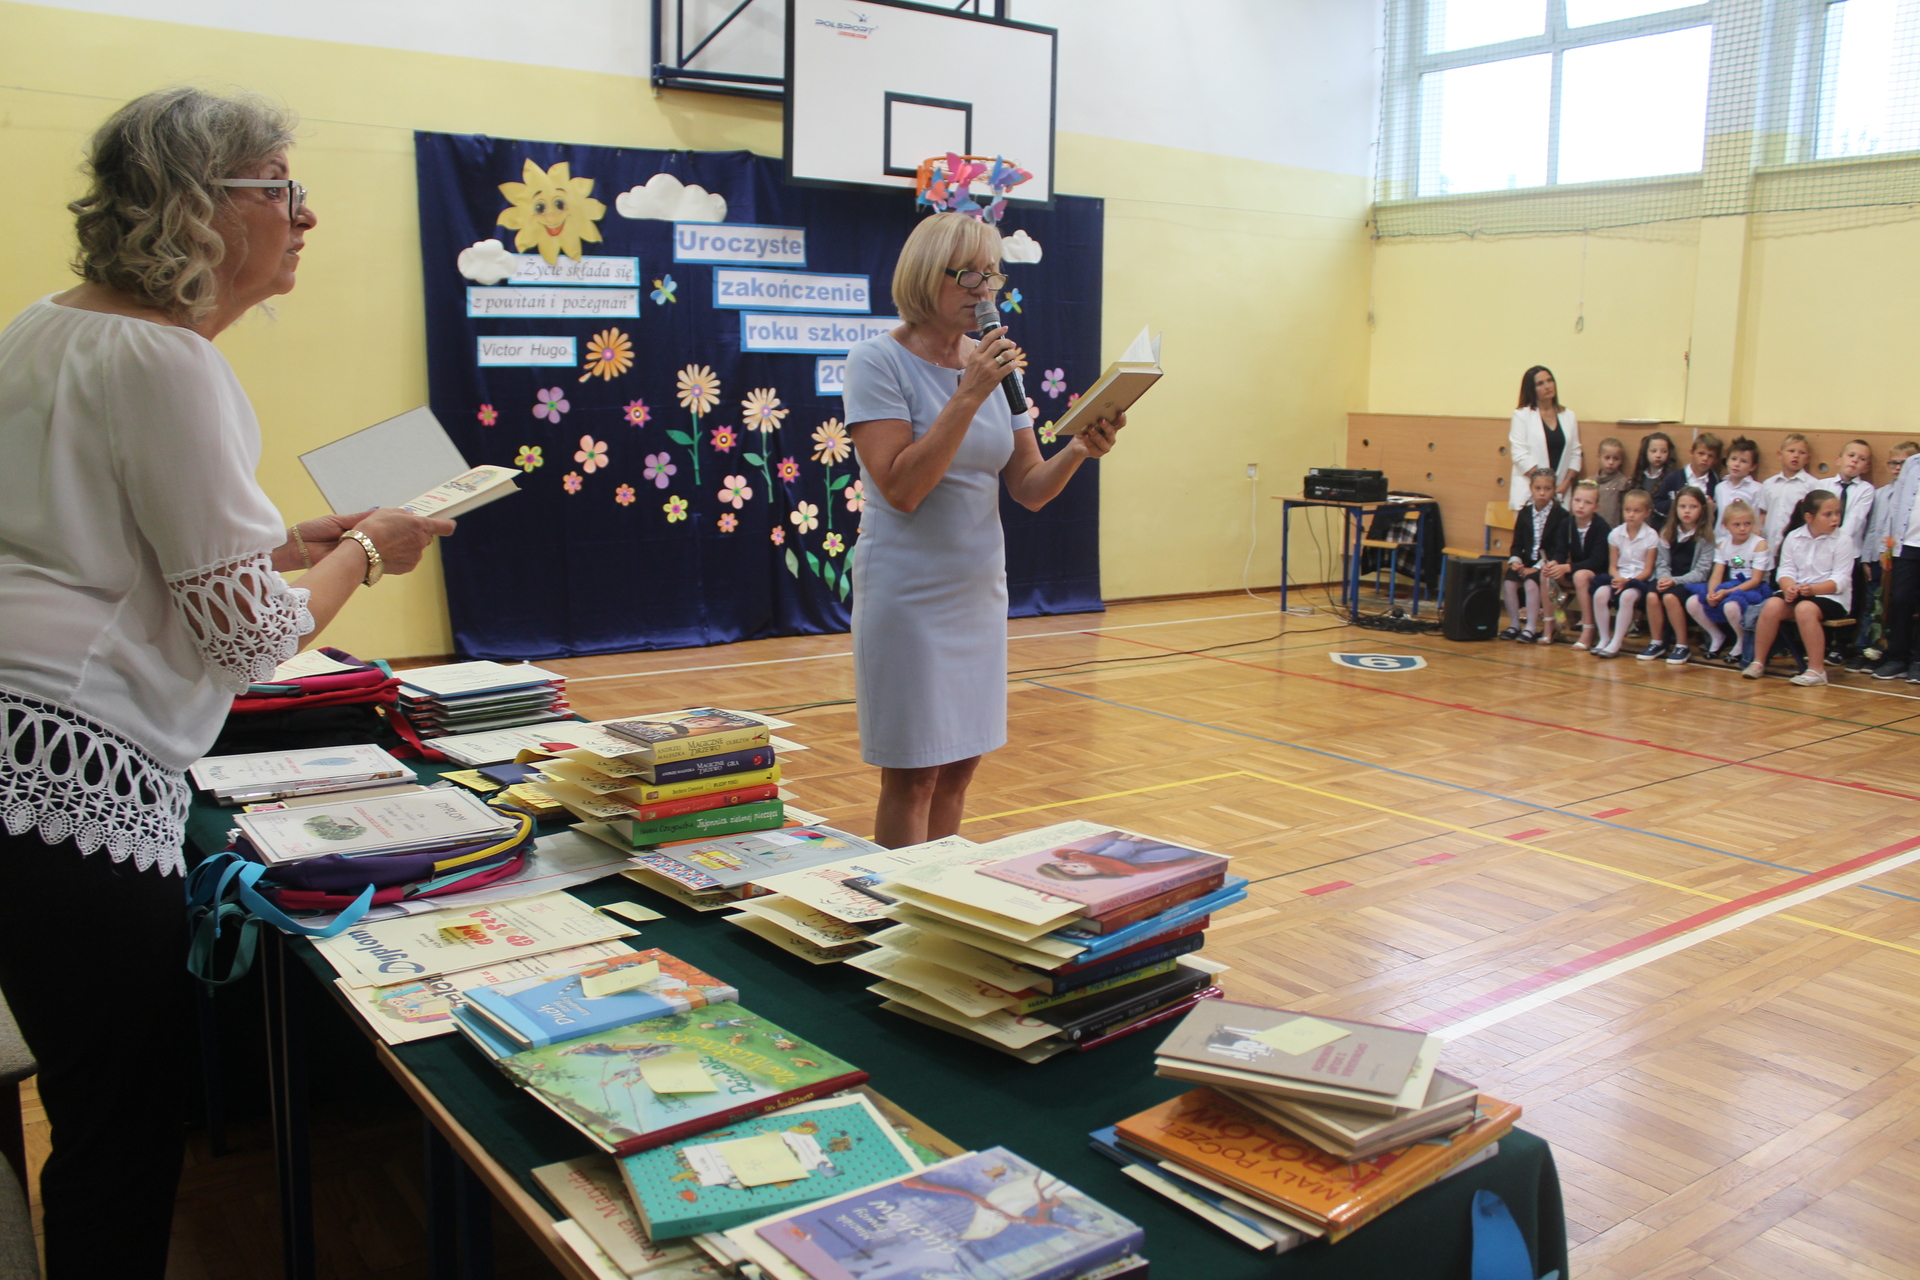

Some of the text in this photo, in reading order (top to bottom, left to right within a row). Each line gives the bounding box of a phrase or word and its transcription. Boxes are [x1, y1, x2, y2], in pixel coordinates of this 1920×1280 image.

[678, 230, 801, 258] Uroczyste
[566, 261, 610, 281] składa
[614, 264, 633, 281] się
[721, 277, 866, 302] zakończenie
[473, 299, 481, 308] z
[485, 294, 546, 313] powitań
[748, 321, 798, 341] roku
[482, 343, 567, 358] Victor Hugo
[687, 738, 723, 750] MAGICZNE
[690, 744, 721, 757] DRZEWO
[696, 760, 725, 770] MAGICZNE
[727, 760, 739, 768] GRA
[348, 929, 425, 974] Dyplom
[536, 1003, 576, 1026] Duch
[655, 1032, 774, 1071] huśtawce
[699, 1055, 756, 1095] Dziadek
[1154, 1121, 1342, 1201] MAŁY POCZET
[567, 1169, 625, 1219] Matylda
[617, 1219, 667, 1262] Krowa
